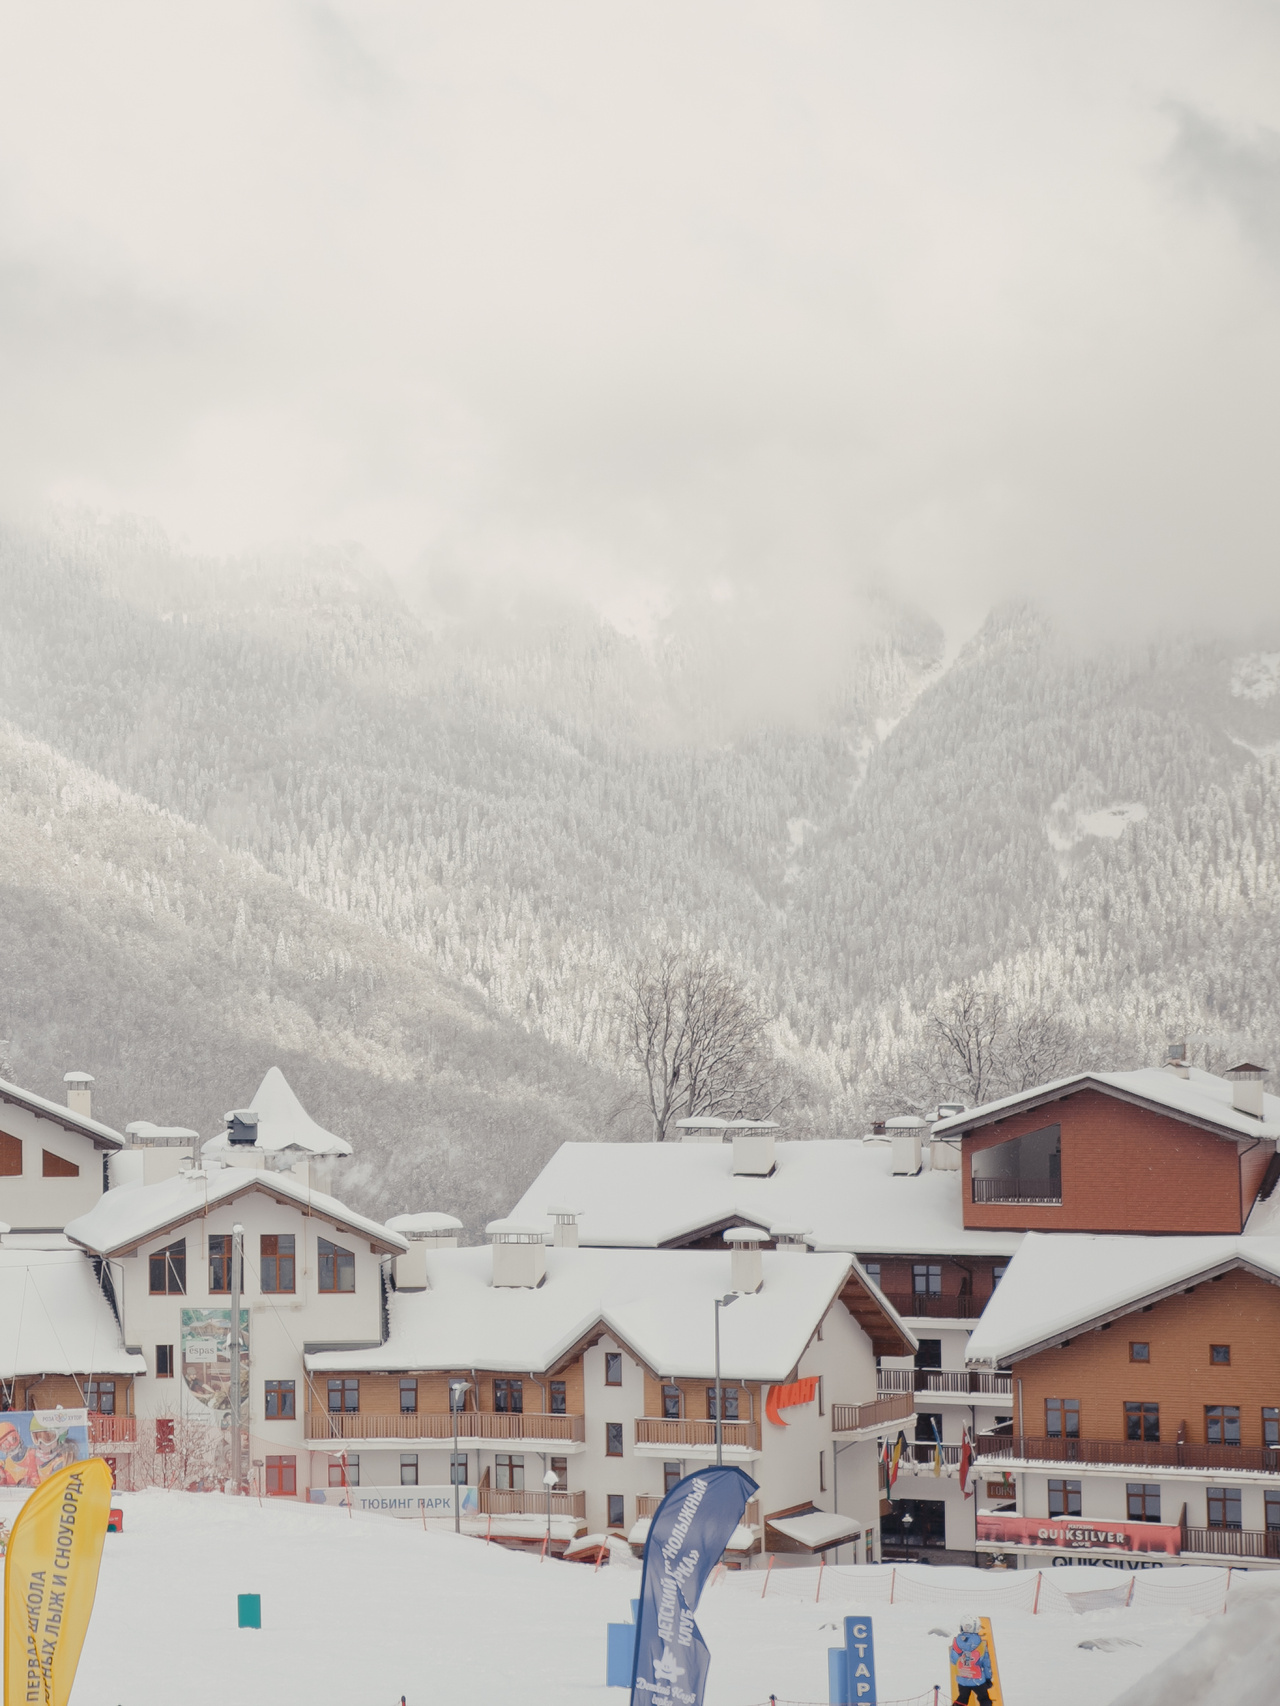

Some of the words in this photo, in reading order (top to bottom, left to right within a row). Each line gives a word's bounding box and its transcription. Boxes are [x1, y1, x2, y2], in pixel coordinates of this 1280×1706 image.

[54, 1471, 83, 1570] СНОУБОРДА
[360, 1498, 413, 1509] ТЮБИНГ
[417, 1498, 450, 1509] ПАРК
[1038, 1528, 1124, 1543] QUIKSILVER
[28, 1570, 46, 1633] ШКОЛА
[52, 1574, 67, 1587] И
[45, 1591, 65, 1637] ЛЫЖ
[657, 1577, 677, 1642] ДЕТСКИЙ
[677, 1608, 695, 1647] КЛУБ
[27, 1635, 41, 1702] ПЕРВАЯ
[853, 1624, 871, 1706] СТАР
